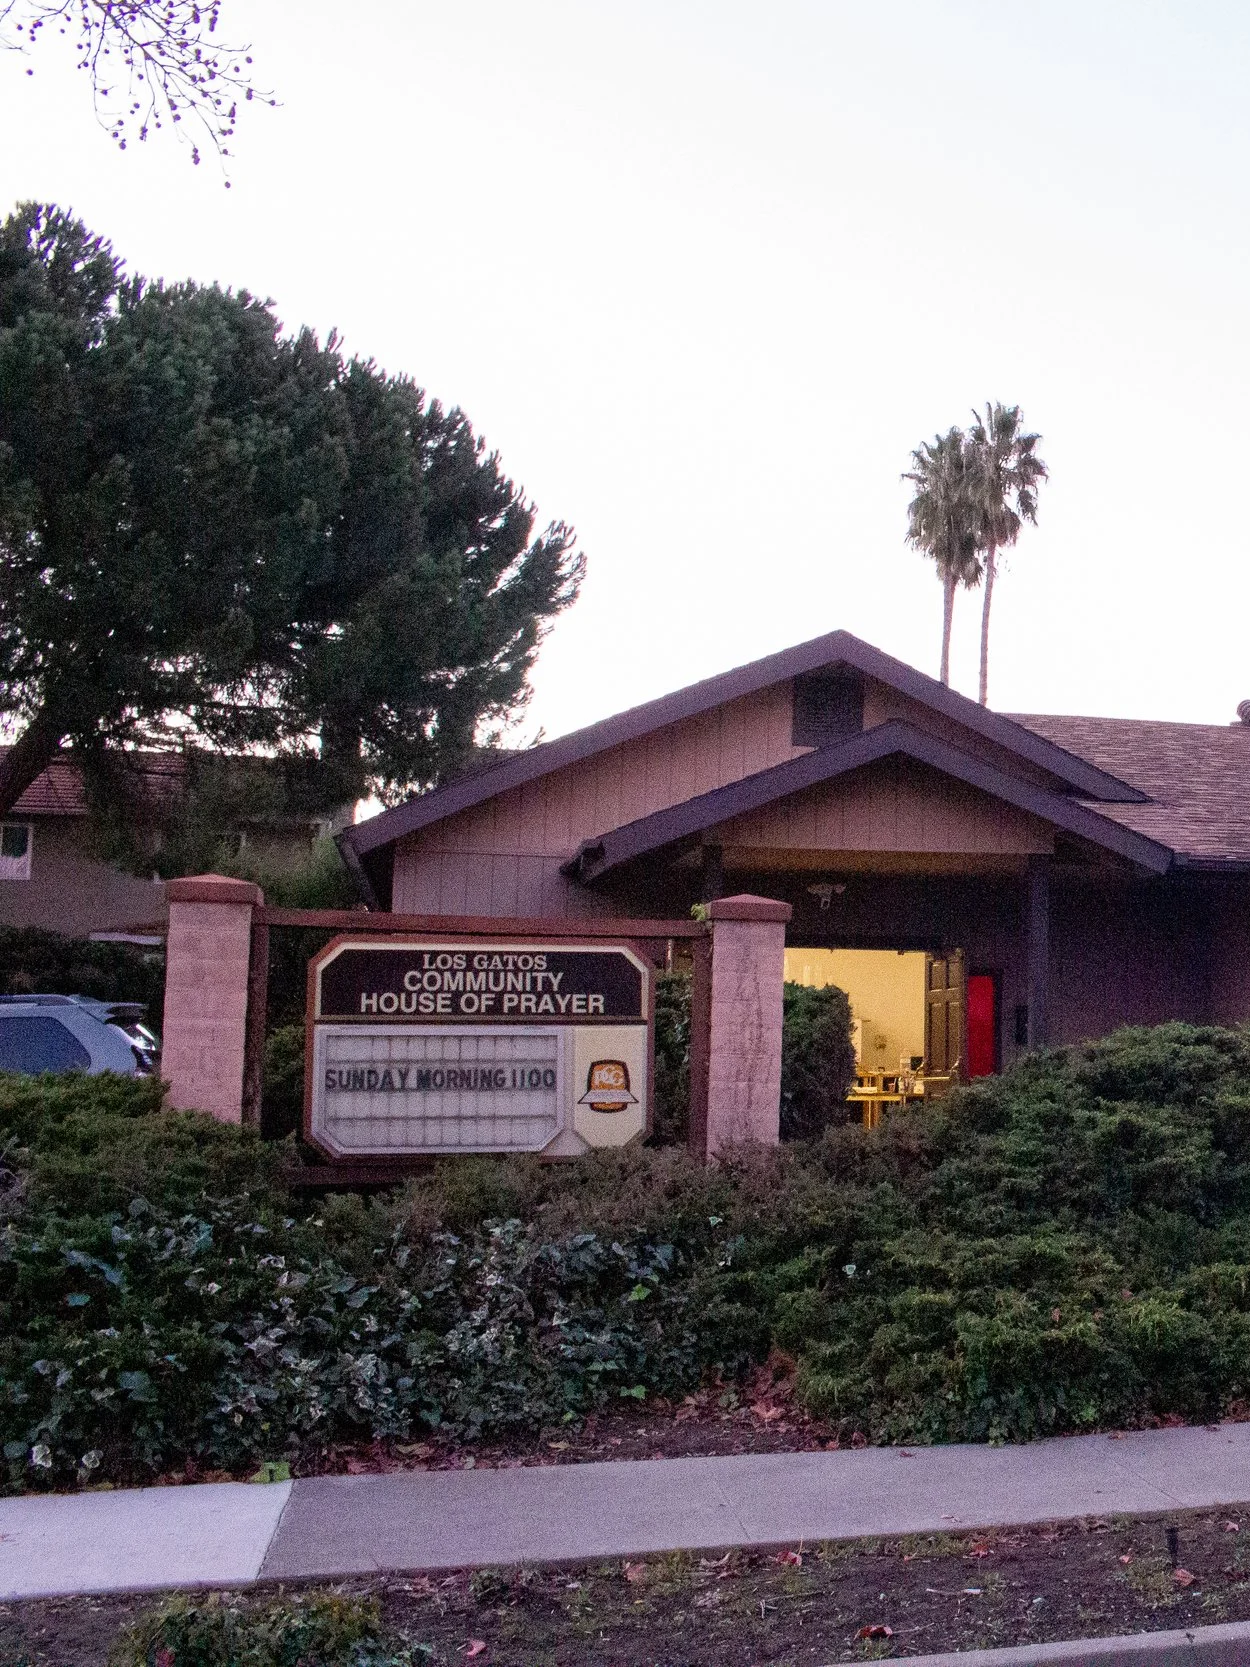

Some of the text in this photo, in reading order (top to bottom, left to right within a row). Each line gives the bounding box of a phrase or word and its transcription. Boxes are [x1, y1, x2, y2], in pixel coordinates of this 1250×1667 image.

[422, 953, 548, 970] LOS GATOS
[403, 971, 564, 992] COMMUNITY
[360, 992, 606, 1015] HOUSE OF PRAYER
[325, 1068, 409, 1091] SUNDAY
[416, 1068, 506, 1091] MORNING
